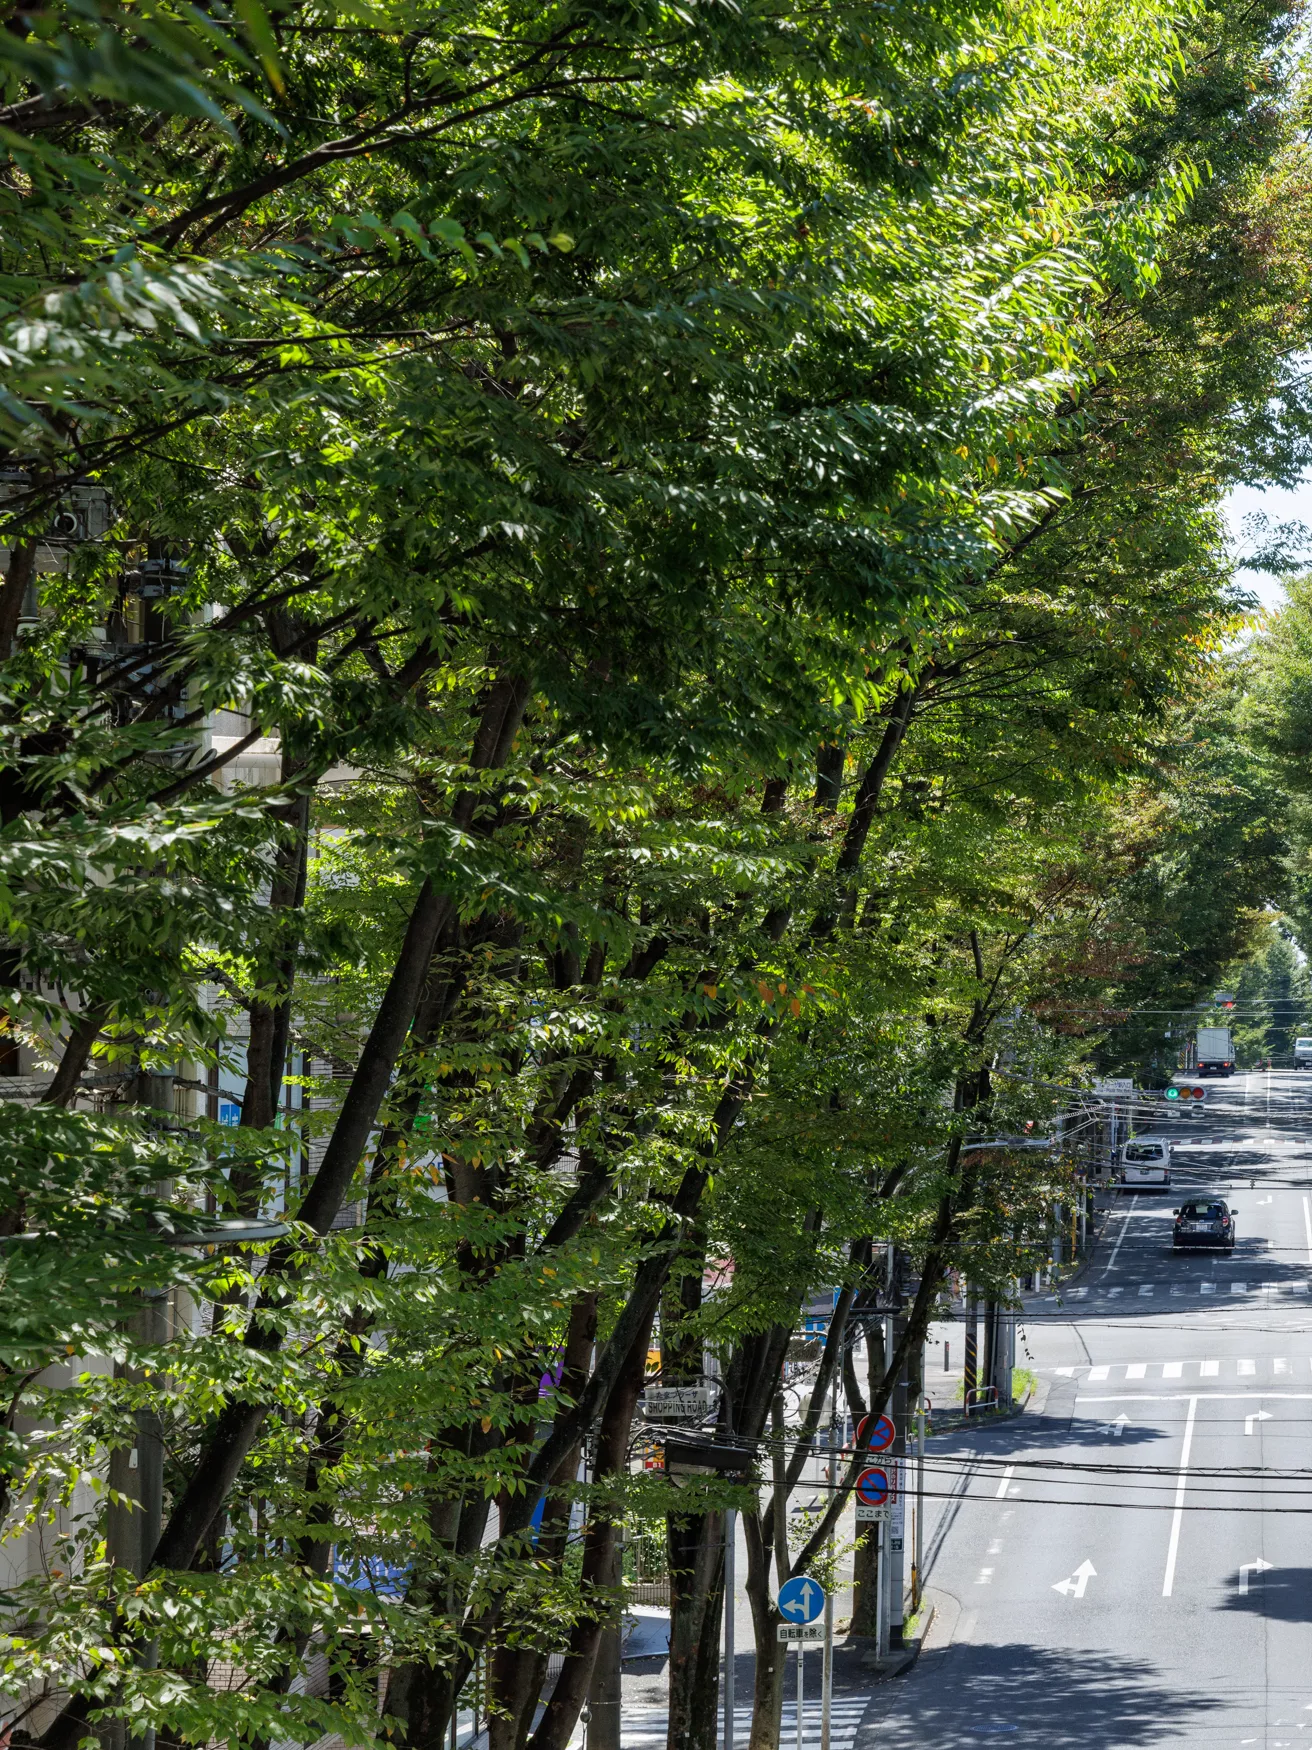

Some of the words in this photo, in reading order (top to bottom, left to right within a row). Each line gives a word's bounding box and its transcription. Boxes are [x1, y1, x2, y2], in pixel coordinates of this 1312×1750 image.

[648, 1400, 685, 1413] SHOPPING
[687, 1401, 707, 1413] ROAD
[857, 1509, 890, 1519] ここまで
[780, 1628, 822, 1639] 自転車を除く
